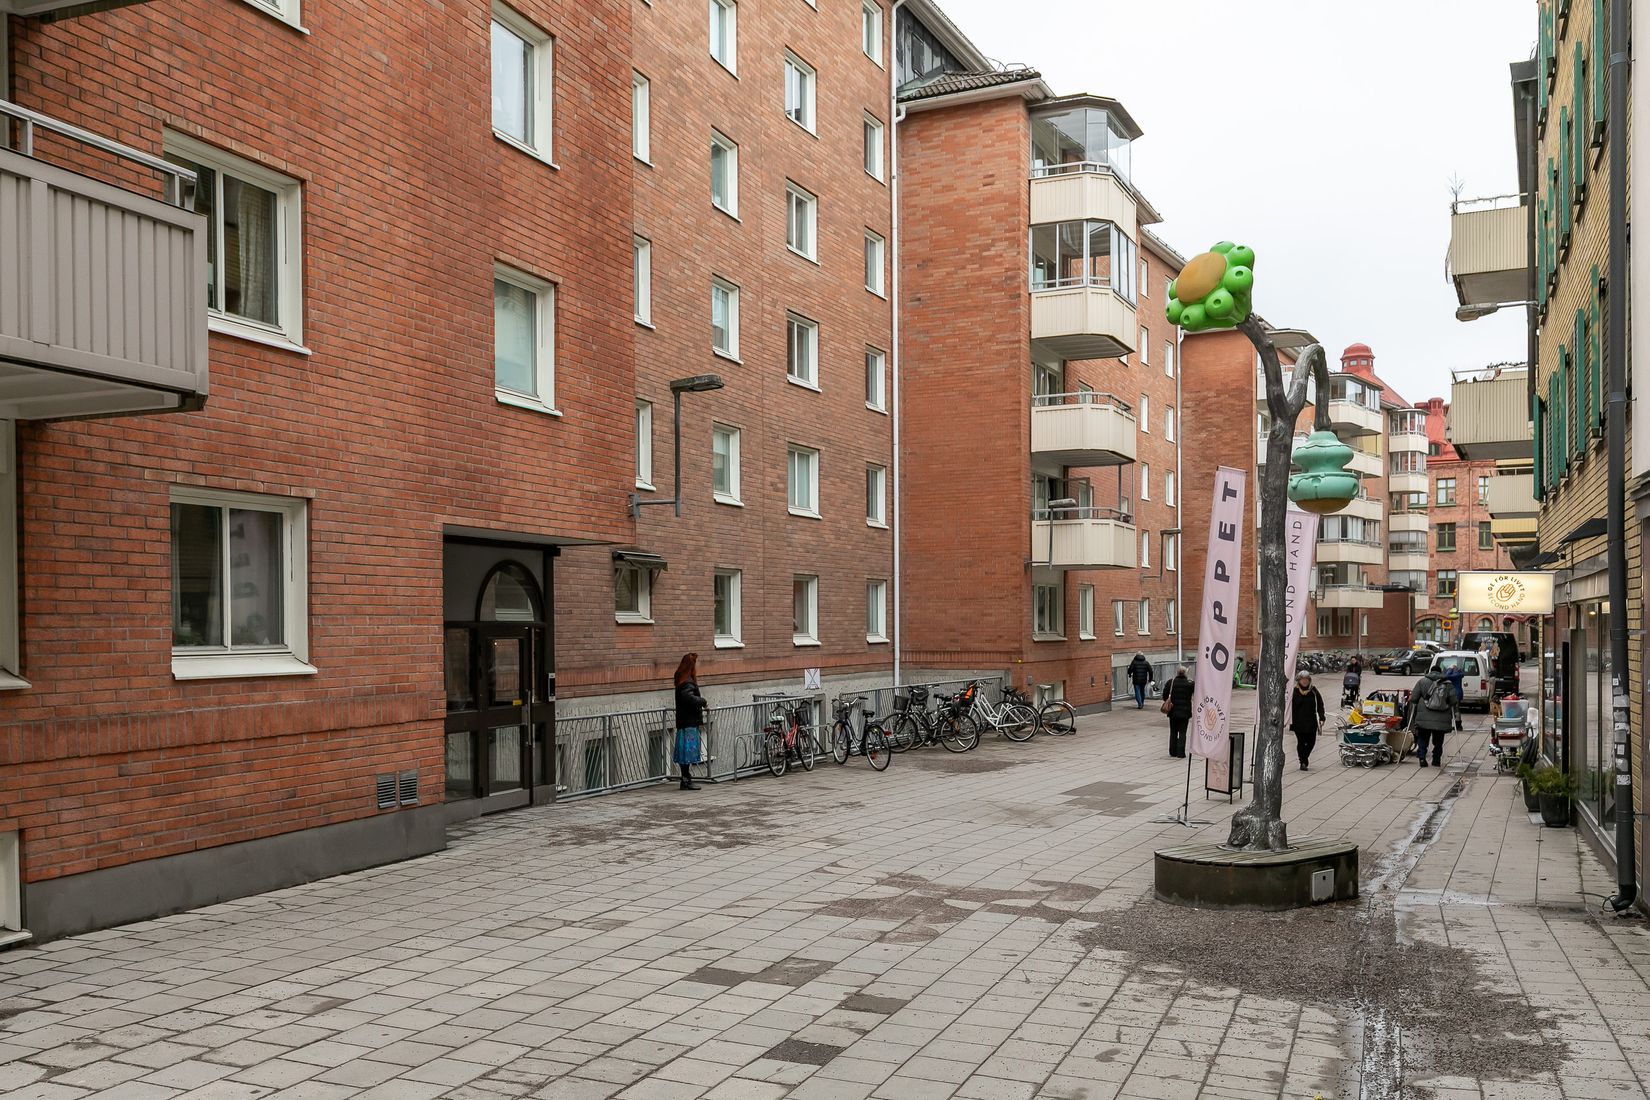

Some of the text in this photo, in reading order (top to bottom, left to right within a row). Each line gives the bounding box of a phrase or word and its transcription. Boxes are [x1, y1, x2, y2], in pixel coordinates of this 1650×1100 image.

[1289, 521, 1302, 571] HAND
[1205, 481, 1237, 671] ÖPPET
[1488, 593, 1525, 609] SECOND HAND
